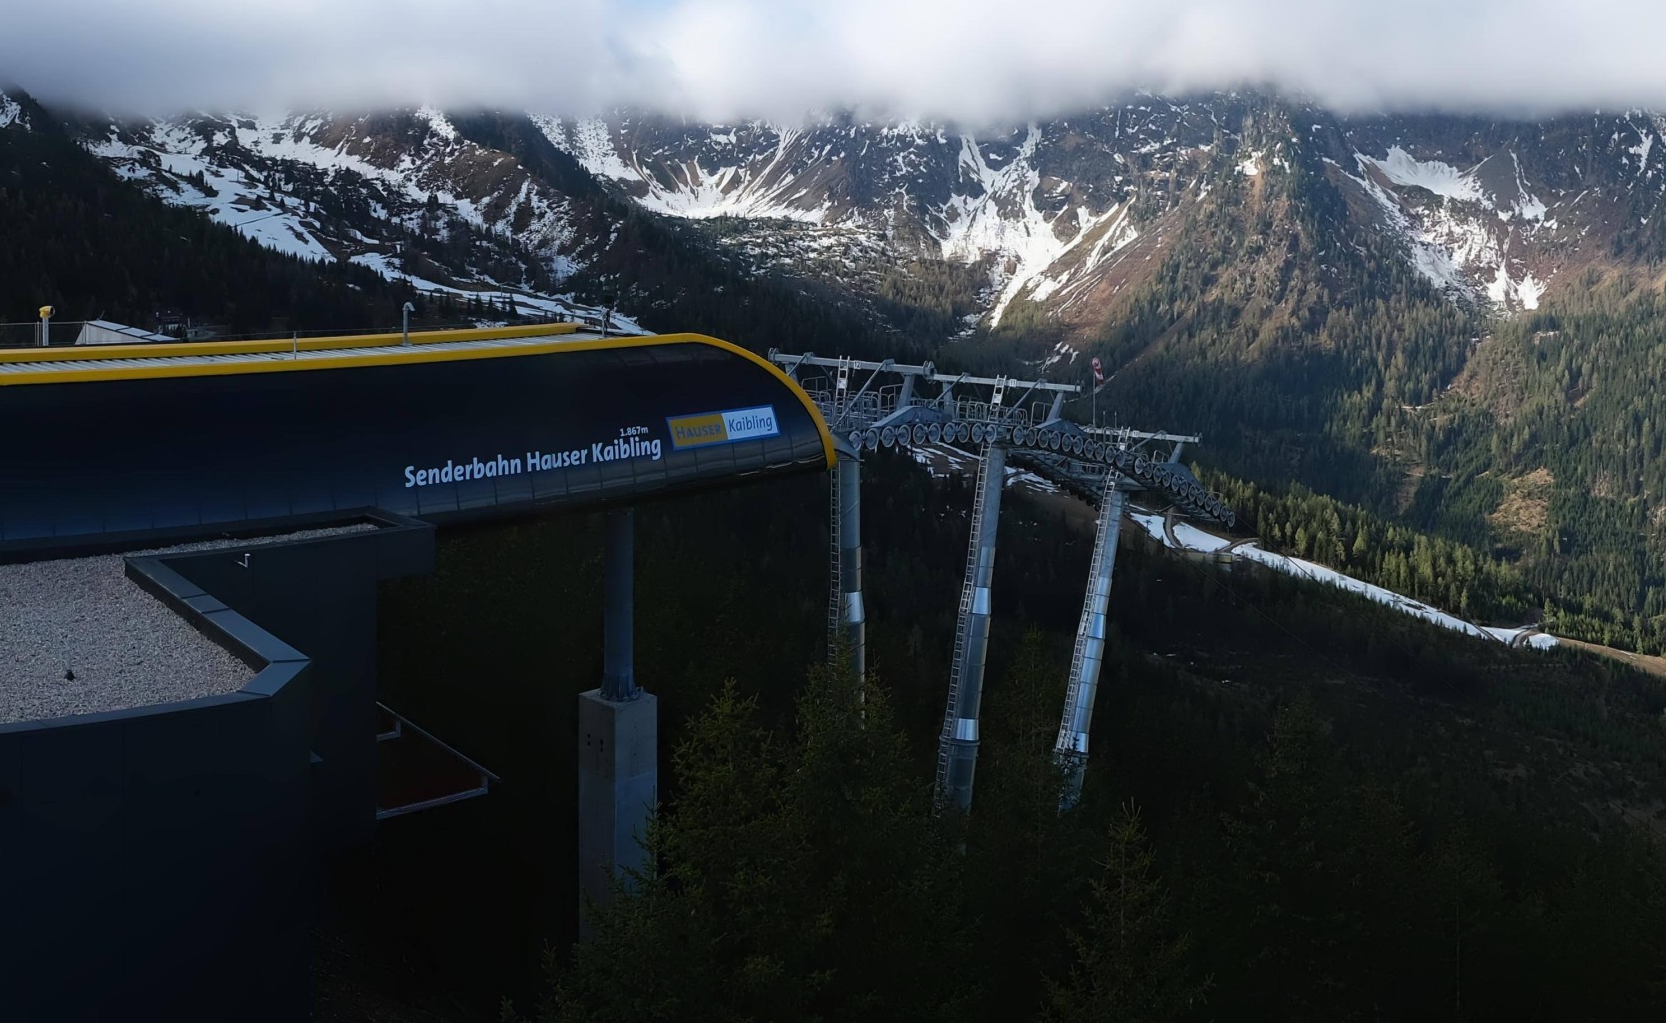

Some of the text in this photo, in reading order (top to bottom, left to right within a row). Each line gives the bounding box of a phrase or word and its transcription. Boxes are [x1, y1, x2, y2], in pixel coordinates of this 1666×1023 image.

[620, 426, 649, 437] 1.867m
[675, 416, 773, 440] HAUSER Kaibling
[404, 436, 662, 488] Senderbahn Hauser Kaibling
